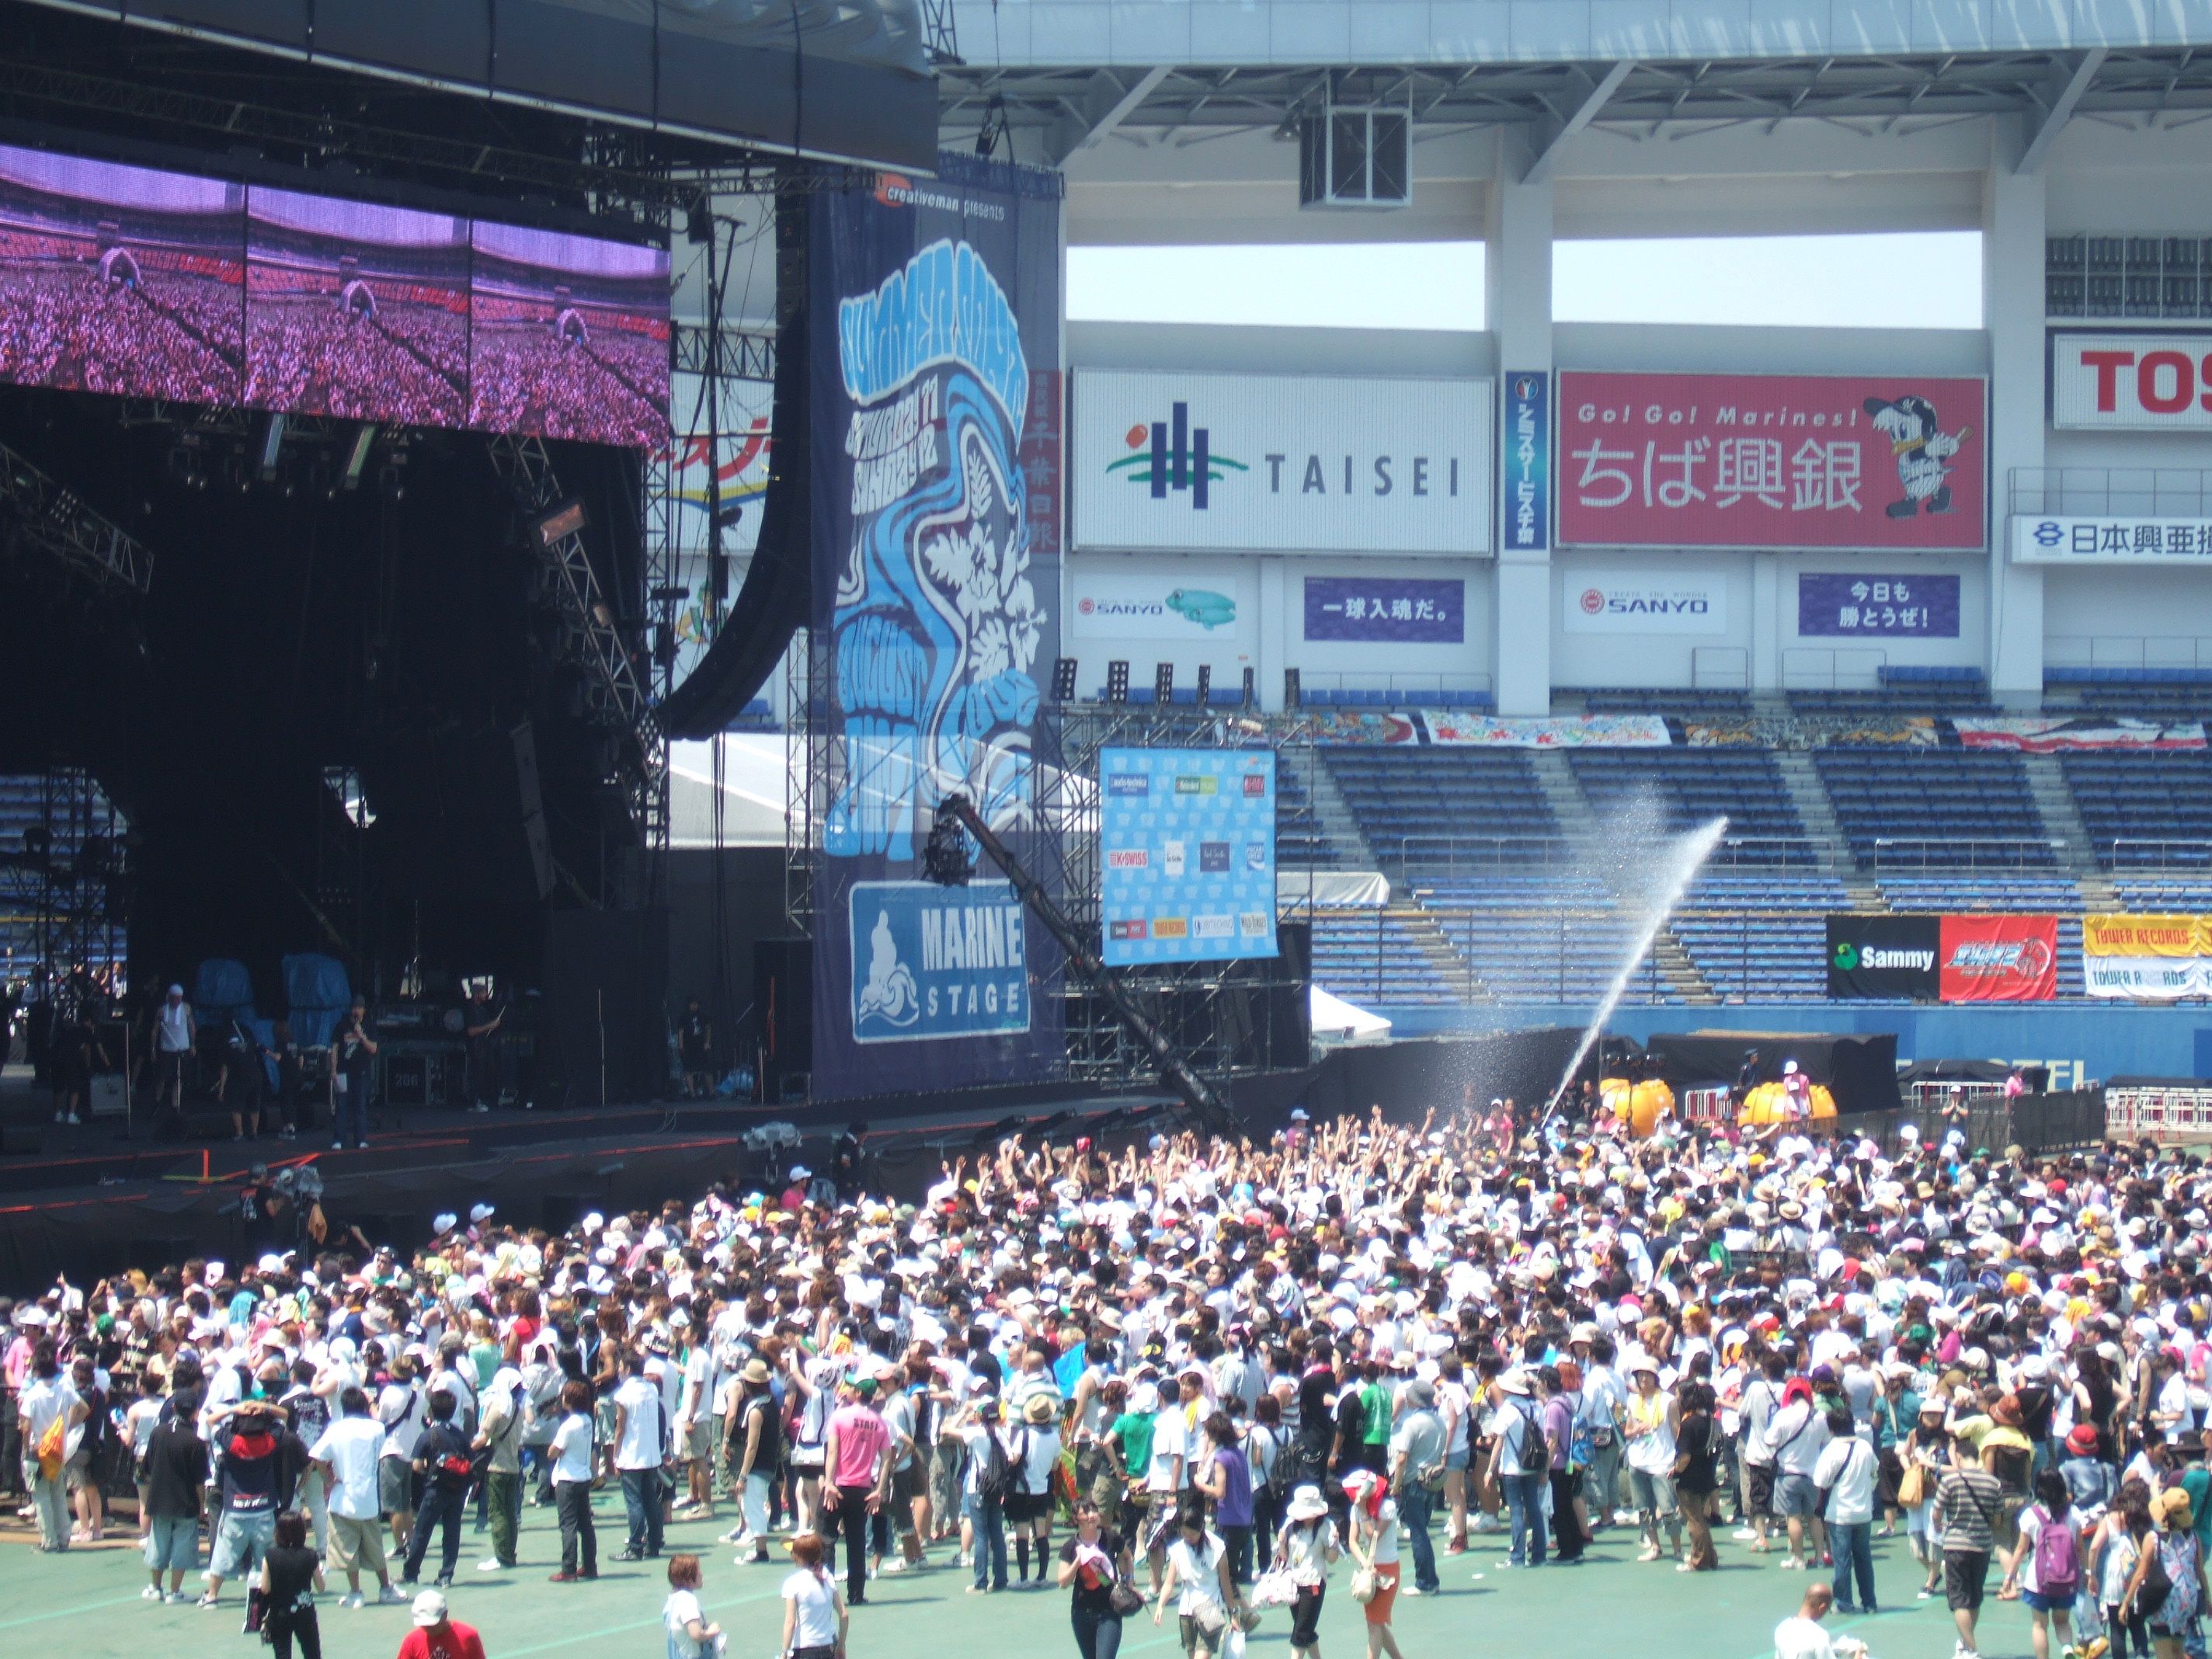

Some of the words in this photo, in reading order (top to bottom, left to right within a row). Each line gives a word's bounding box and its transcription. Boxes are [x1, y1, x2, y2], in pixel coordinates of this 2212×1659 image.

[887, 186, 958, 211] creativeman
[964, 200, 1005, 221] presents
[2081, 350, 2212, 414] TO
[1578, 403, 1630, 423] Go!
[1644, 405, 1697, 424] Go!
[1716, 405, 1858, 430] Marines!
[1264, 454, 1459, 496] TAISEI
[1571, 435, 1862, 513] ちば興銀
[1850, 580, 1911, 603] 今日も
[1097, 604, 1163, 615] SANYO
[1323, 596, 1446, 621] 一球入魂だ。
[1609, 599, 1709, 614] SANYO
[921, 906, 1022, 971] MARINE
[2095, 928, 2133, 945] TOWER
[2137, 928, 2189, 945] RECORDS
[1862, 946, 1934, 972] Sammy
[2093, 971, 2131, 986] TOWER
[927, 982, 1020, 1017] STAGE
